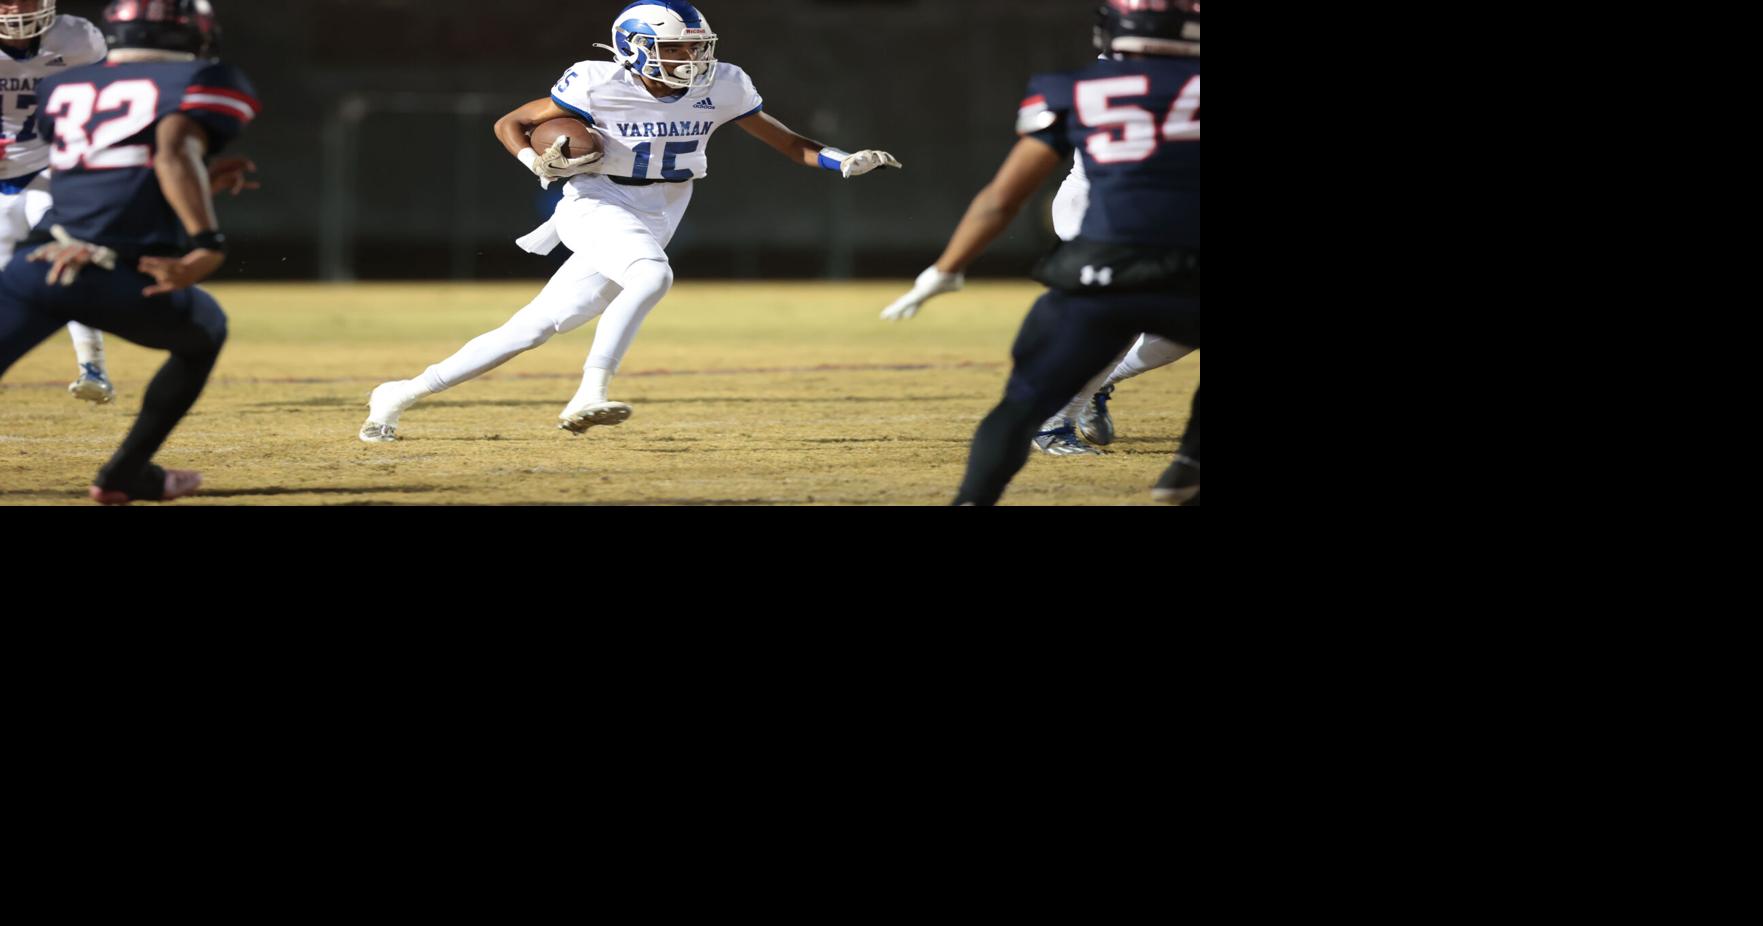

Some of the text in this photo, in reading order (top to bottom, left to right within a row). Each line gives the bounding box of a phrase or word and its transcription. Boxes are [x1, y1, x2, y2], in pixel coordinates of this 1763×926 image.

[0, 94, 38, 142] 7
[46, 79, 157, 169] 32
[617, 121, 714, 137] VARDAMAN
[632, 140, 699, 180] 15
